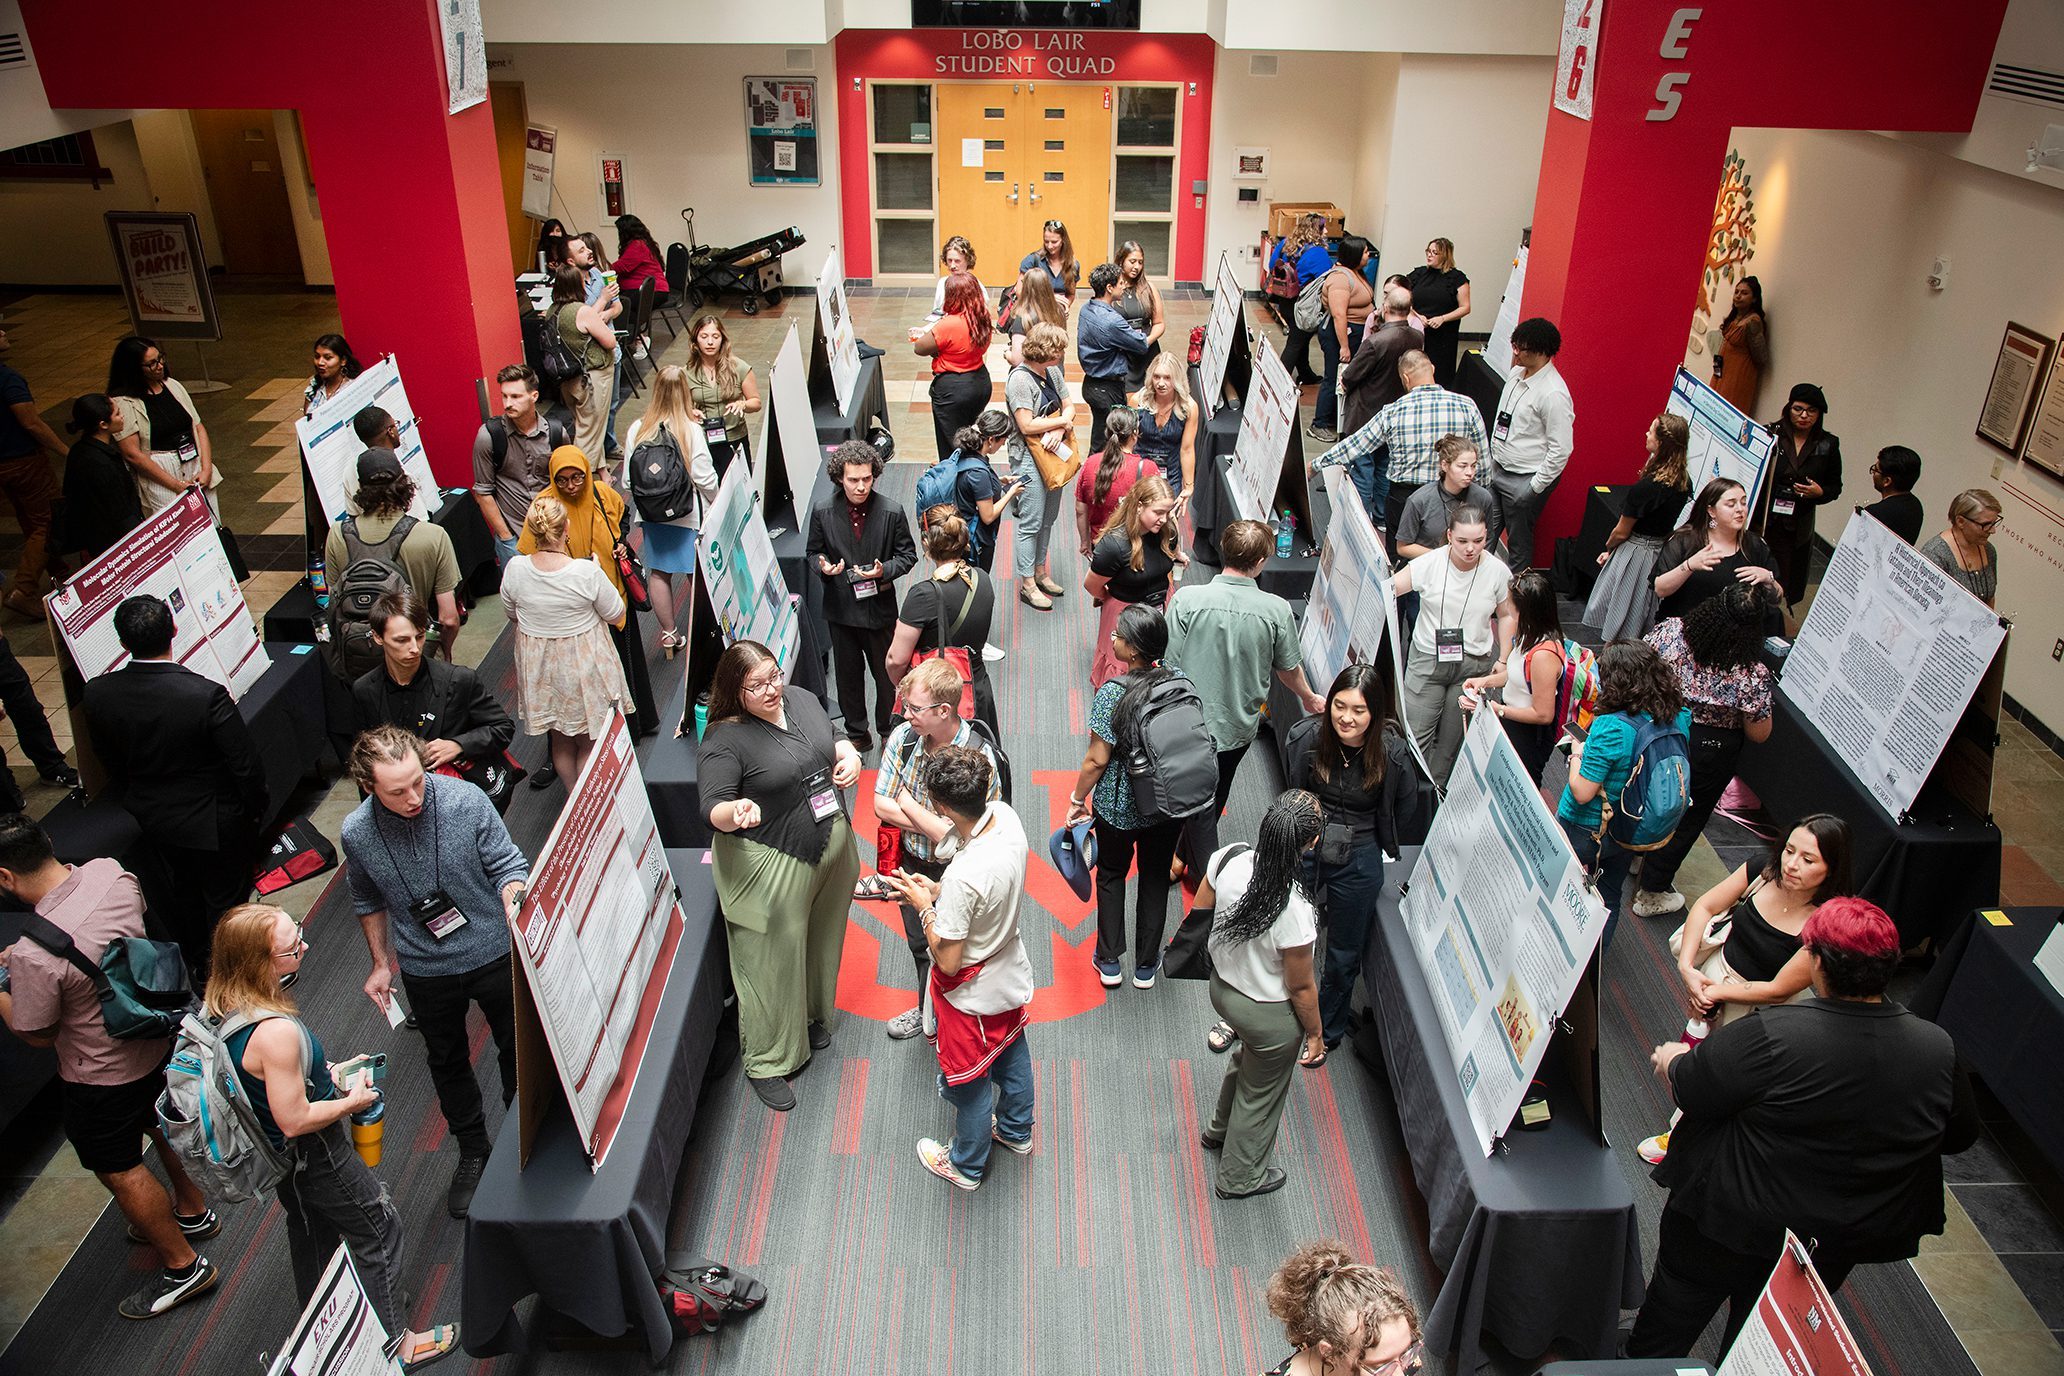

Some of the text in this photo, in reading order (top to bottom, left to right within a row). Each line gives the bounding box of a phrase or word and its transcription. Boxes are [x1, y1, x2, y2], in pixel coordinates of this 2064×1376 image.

[962, 32, 1086, 50] LOBO LAIR
[936, 55, 1116, 78] STUDENT QUAD
[130, 235, 176, 258] BUILD
[134, 250, 187, 277] PARTY!
[186, 491, 198, 505] NM
[82, 564, 108, 588] Molecular
[107, 548, 129, 568] Dynamics
[128, 528, 153, 551] Simulation
[152, 524, 159, 533] of
[158, 514, 172, 529] KIF14
[100, 570, 116, 585] Motor
[114, 558, 131, 574] Protein
[130, 539, 154, 561] Structural
[2001, 525, 2024, 544] THOSE
[2028, 542, 2044, 557] WHO
[1887, 551, 1944, 605] Tattoos and Their Meanings
[1894, 542, 1946, 590] A Historical Approach to
[1888, 567, 1897, 580] in
[1893, 572, 1915, 597] American
[1911, 587, 1931, 611] Society
[1876, 640, 1892, 656] ABSTRACT
[1958, 634, 1971, 646] IMPACT
[1498, 748, 1516, 780] Grandparent
[1526, 799, 1541, 825] Financial
[1551, 842, 1559, 858] and
[1506, 778, 1522, 808] Community
[1520, 803, 1541, 841] Characteristics
[1873, 783, 1894, 808] MORRIS
[531, 886, 540, 907] The
[537, 866, 550, 893] Effect
[1566, 883, 1586, 927] MOORE
[314, 1296, 337, 1344] EKU
[319, 1318, 338, 1355] SCHOLARS
[338, 1289, 354, 1319] PROGRAM
